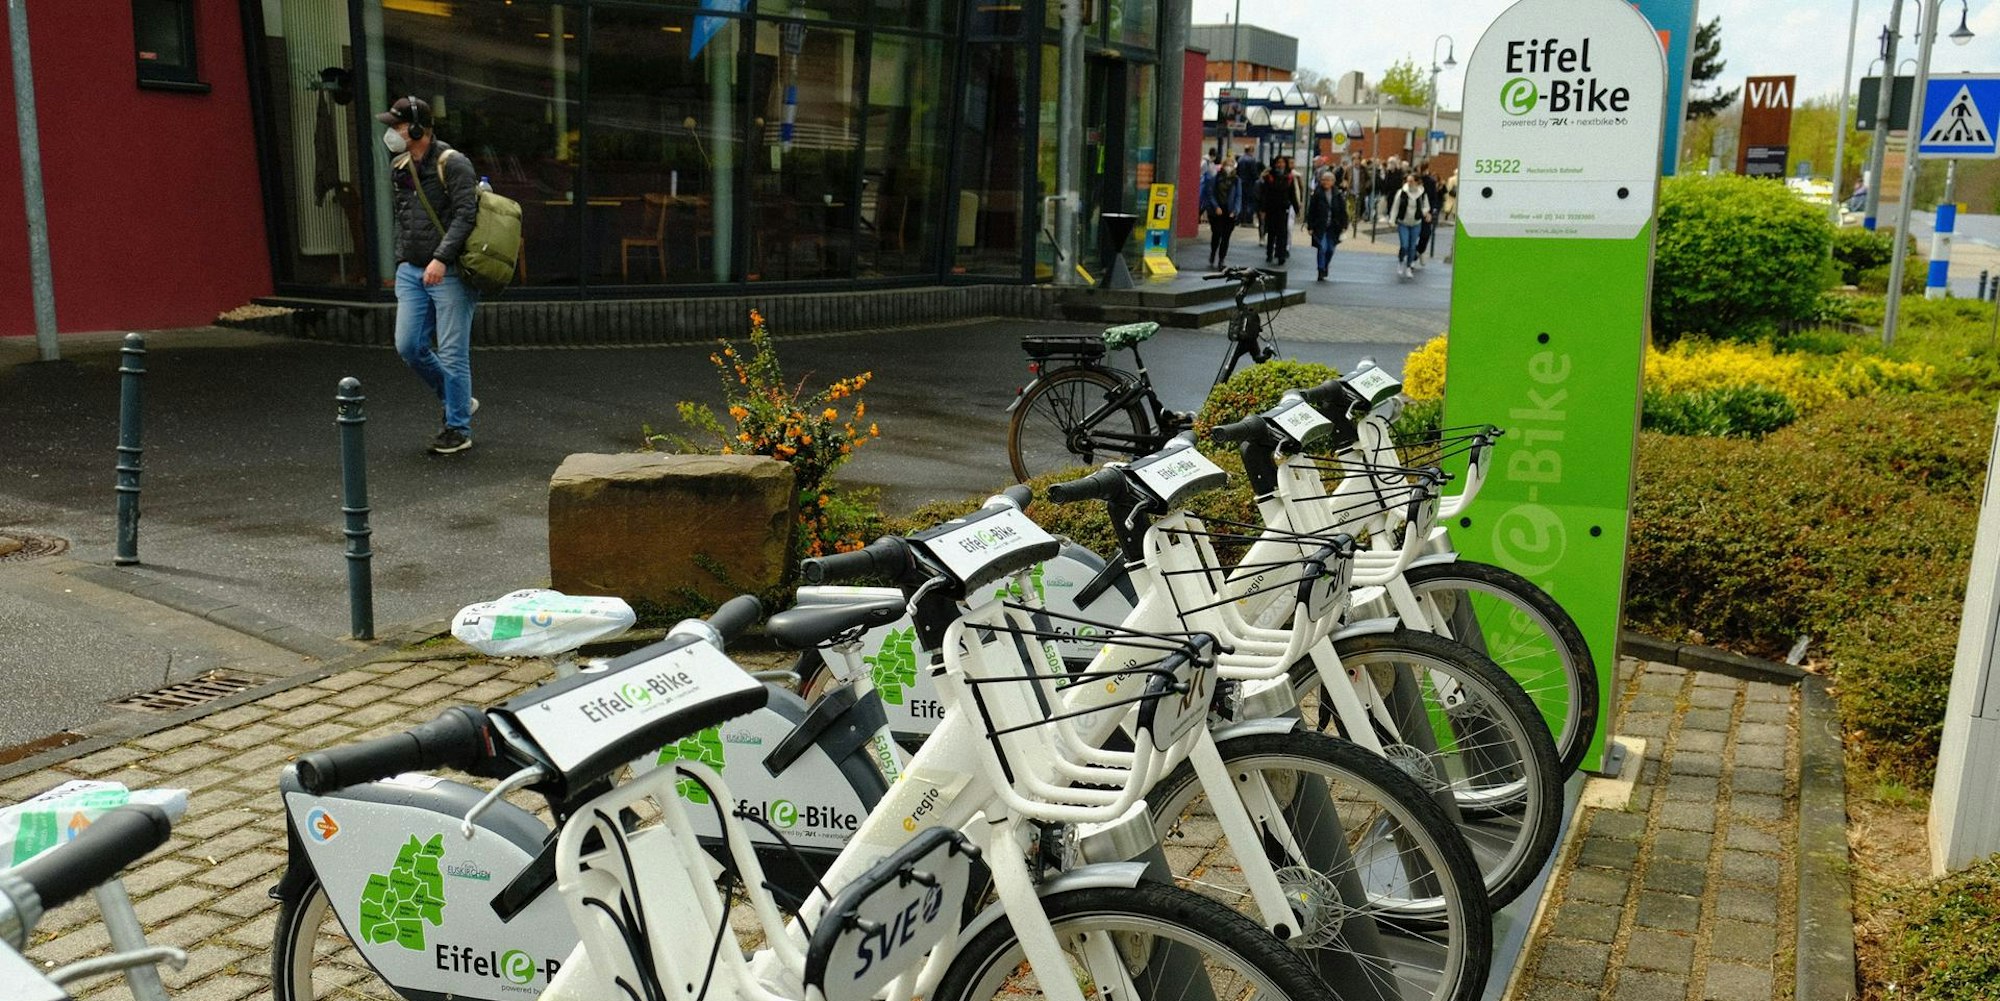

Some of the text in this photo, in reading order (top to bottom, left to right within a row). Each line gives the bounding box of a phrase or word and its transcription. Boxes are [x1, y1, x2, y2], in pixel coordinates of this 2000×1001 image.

[1506, 37, 1591, 73] Eifel
[1749, 81, 1789, 109] VIA
[1502, 118, 1536, 128] powered
[1538, 117, 1549, 128] by
[1577, 117, 1614, 126] nextbike
[1474, 159, 1521, 173] 53522
[579, 691, 633, 723] Eifel
[854, 898, 920, 980] SVE
[436, 944, 500, 978] Eifel
[501, 985, 532, 995] powered
